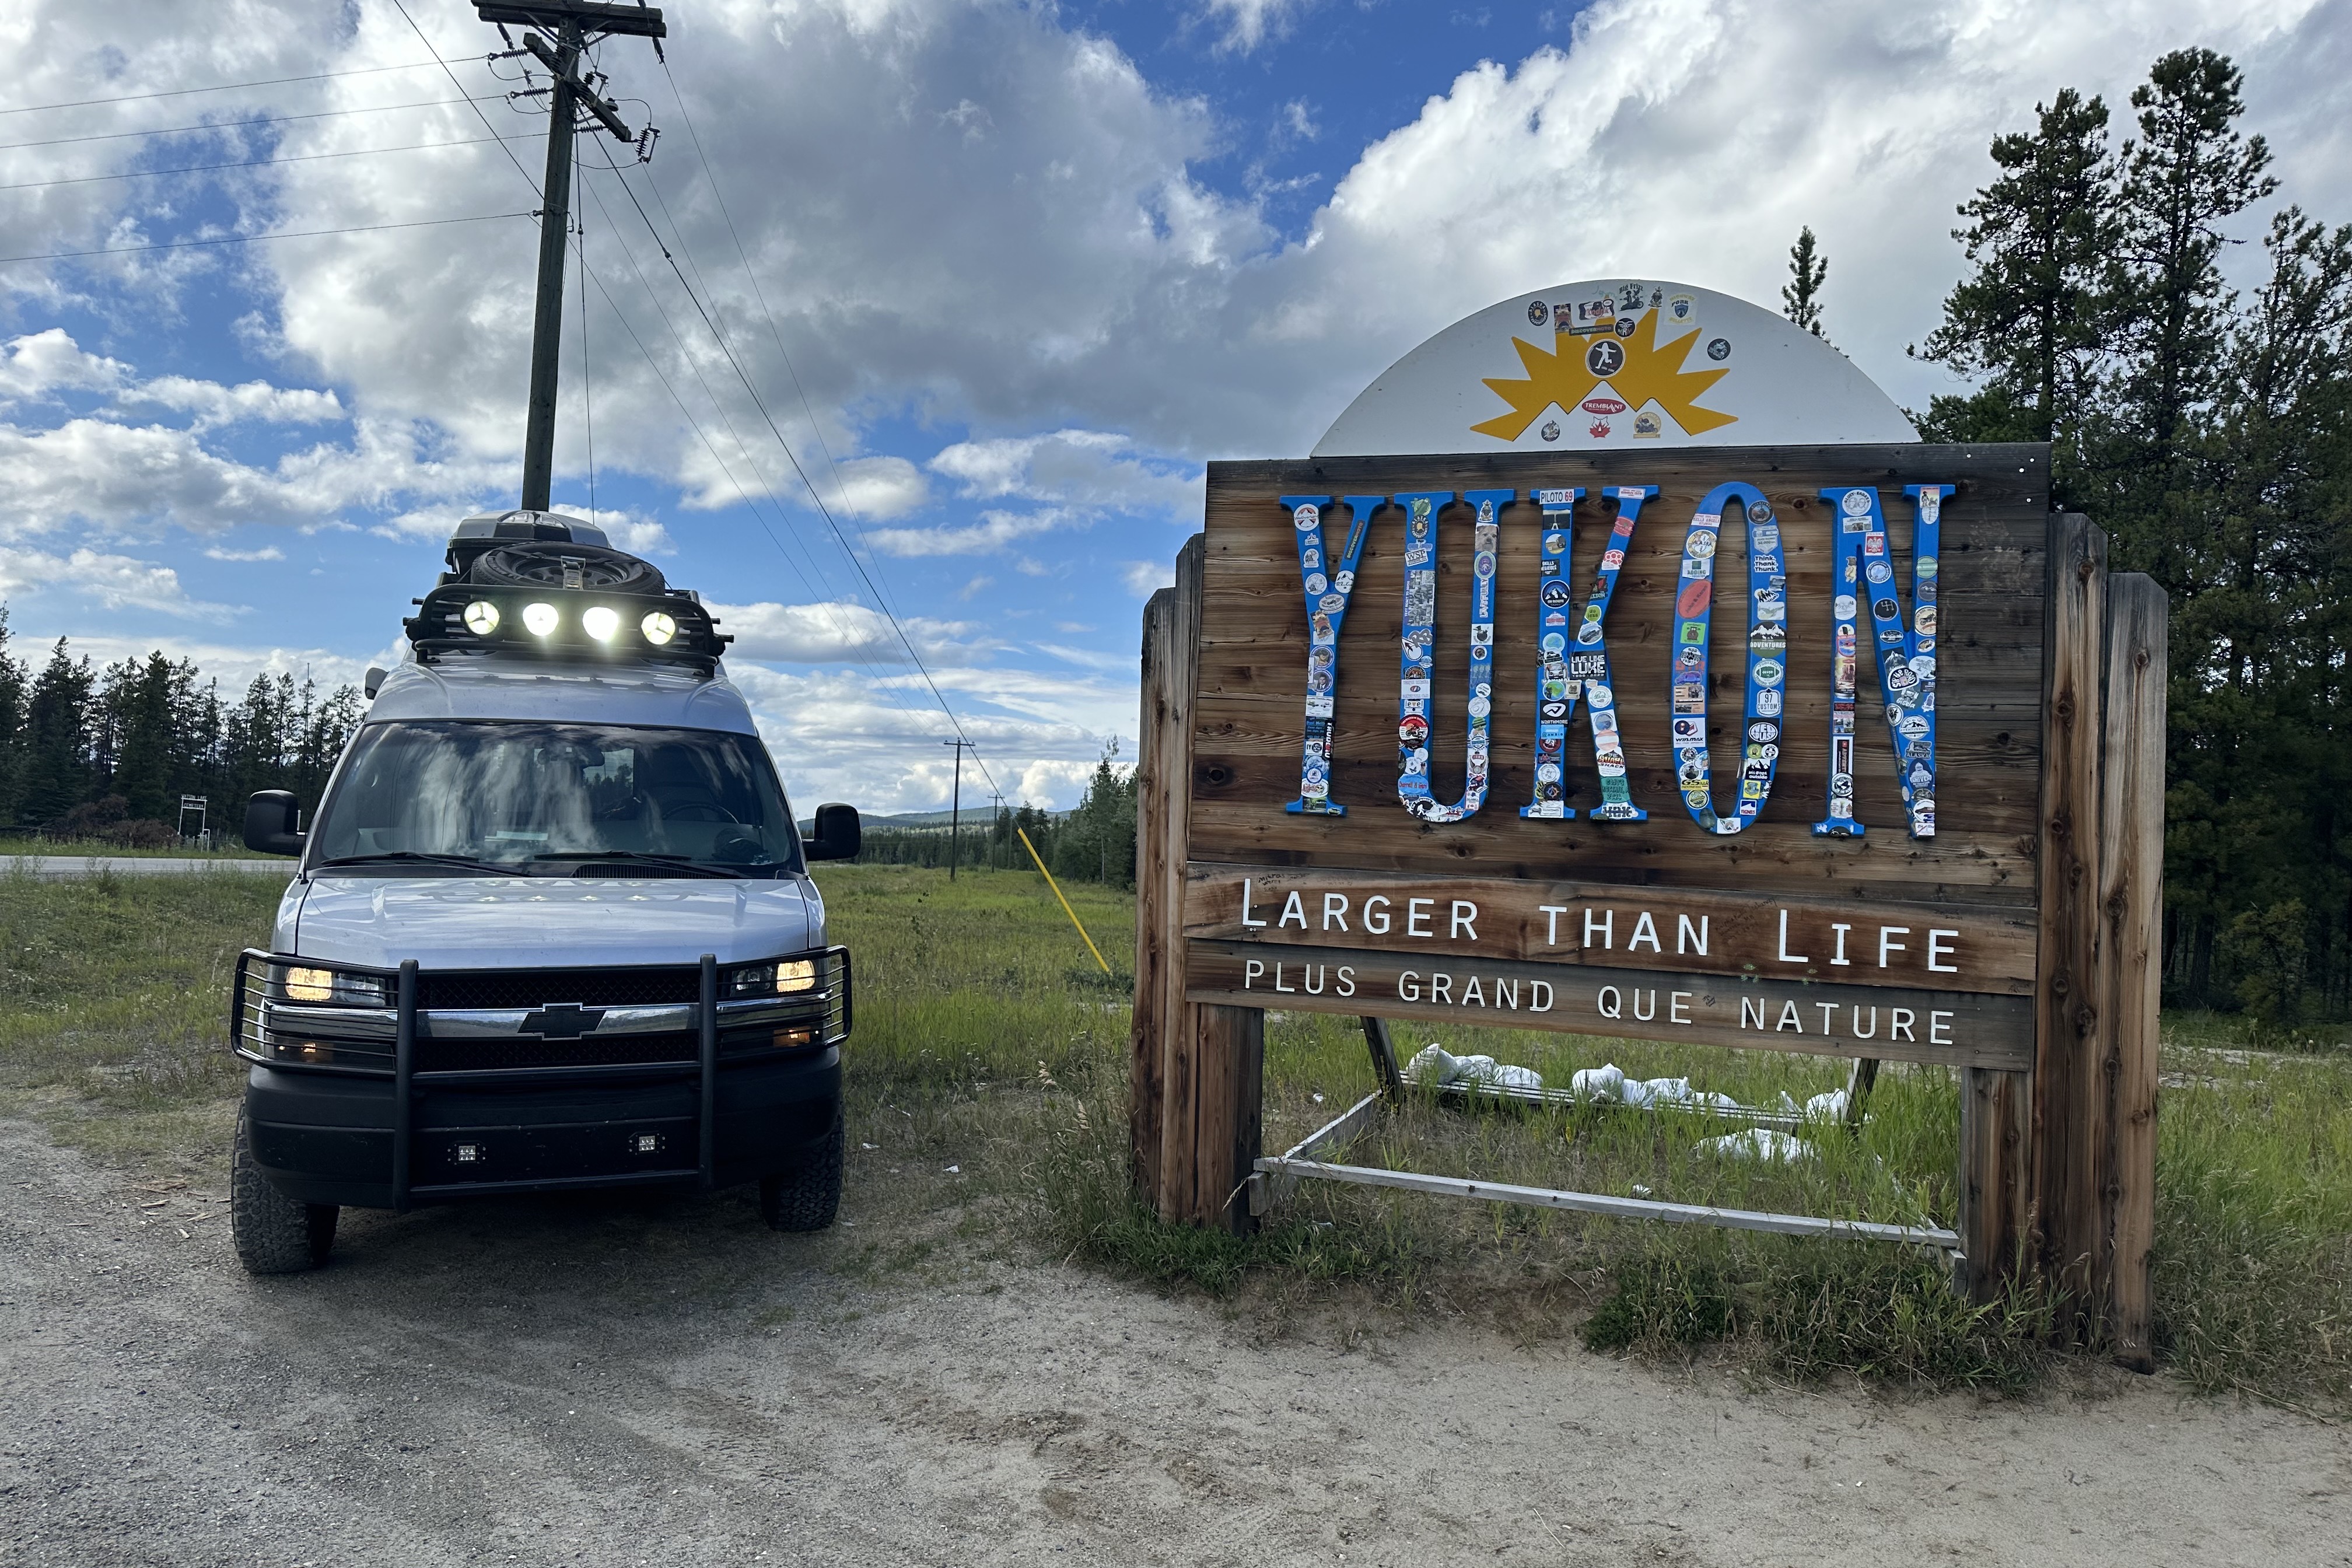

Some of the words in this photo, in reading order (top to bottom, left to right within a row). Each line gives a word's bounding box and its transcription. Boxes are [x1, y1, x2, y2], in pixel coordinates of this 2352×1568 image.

[1585, 402, 1623, 413] TREMBLANT
[1541, 492, 1563, 503] PILOTO
[1564, 491, 1573, 501] 69
[1406, 550, 1425, 561] WSP
[1279, 480, 1957, 839] YUKON
[1572, 662, 1605, 674] LUKE
[1765, 694, 1773, 703] 97
[1242, 878, 1478, 940] LARGER
[1539, 905, 1709, 956] THAN
[1779, 909, 1959, 972] LIFE
[1245, 960, 1356, 997] PLUS
[1398, 970, 1554, 1013] GRAND
[1597, 985, 1692, 1025] QUE
[1740, 996, 1954, 1045] NATURE
